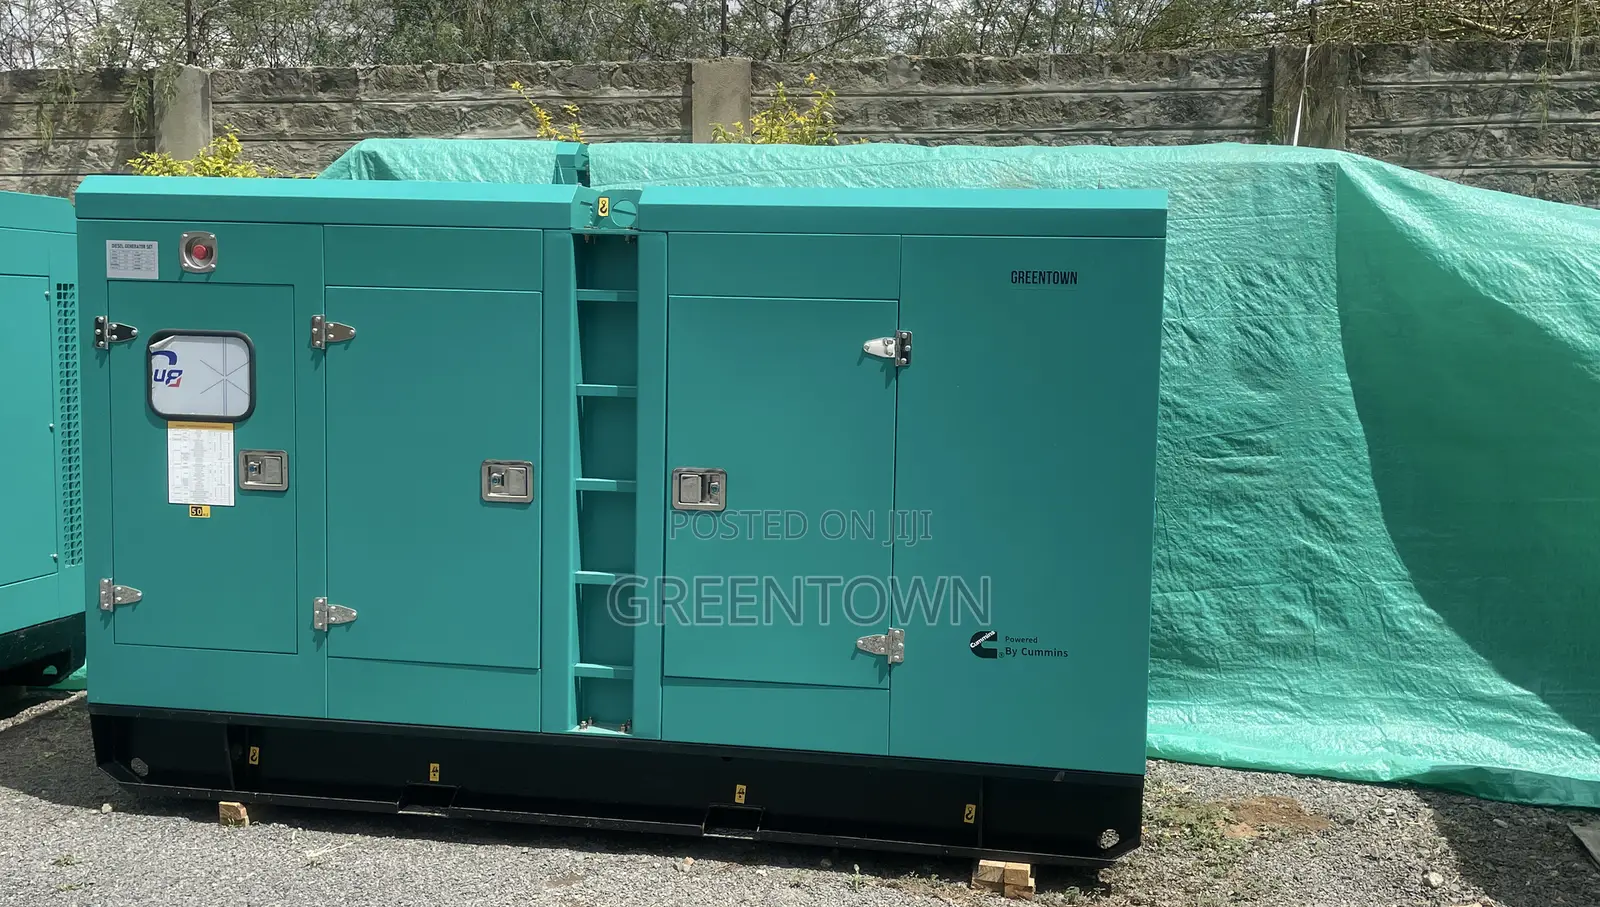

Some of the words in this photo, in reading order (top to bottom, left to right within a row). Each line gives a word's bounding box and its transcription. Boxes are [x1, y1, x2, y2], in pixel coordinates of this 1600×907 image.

[1011, 270, 1078, 284] GREENTOWN
[970, 630, 996, 649] Cummins
[1005, 647, 1017, 657] By
[1021, 648, 1069, 658] Cummins
